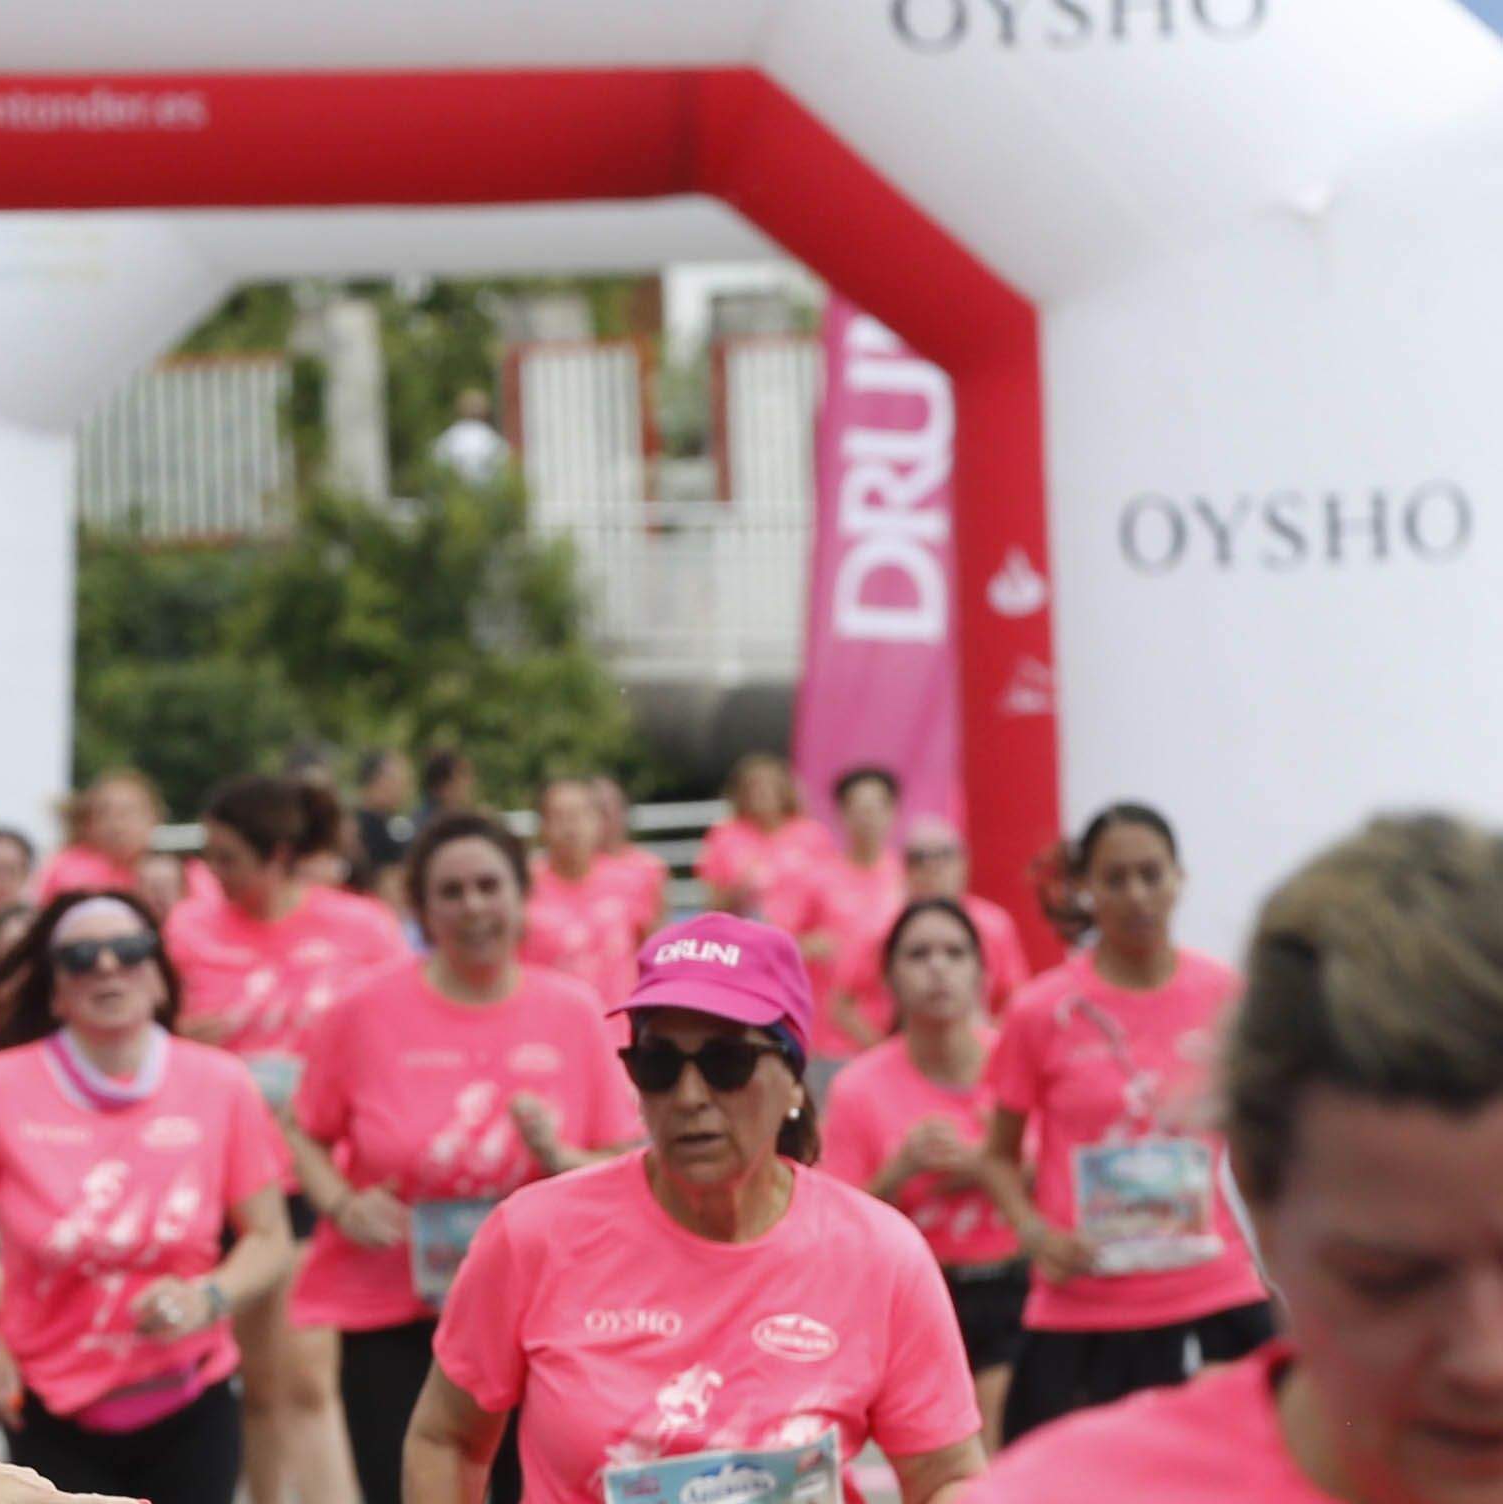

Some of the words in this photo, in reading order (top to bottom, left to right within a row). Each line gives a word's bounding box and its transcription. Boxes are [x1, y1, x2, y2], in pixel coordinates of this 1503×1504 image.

[1116, 477, 1475, 579] OYSHO
[653, 938, 741, 967] DRUNI
[584, 1309, 683, 1337] OYSHO
